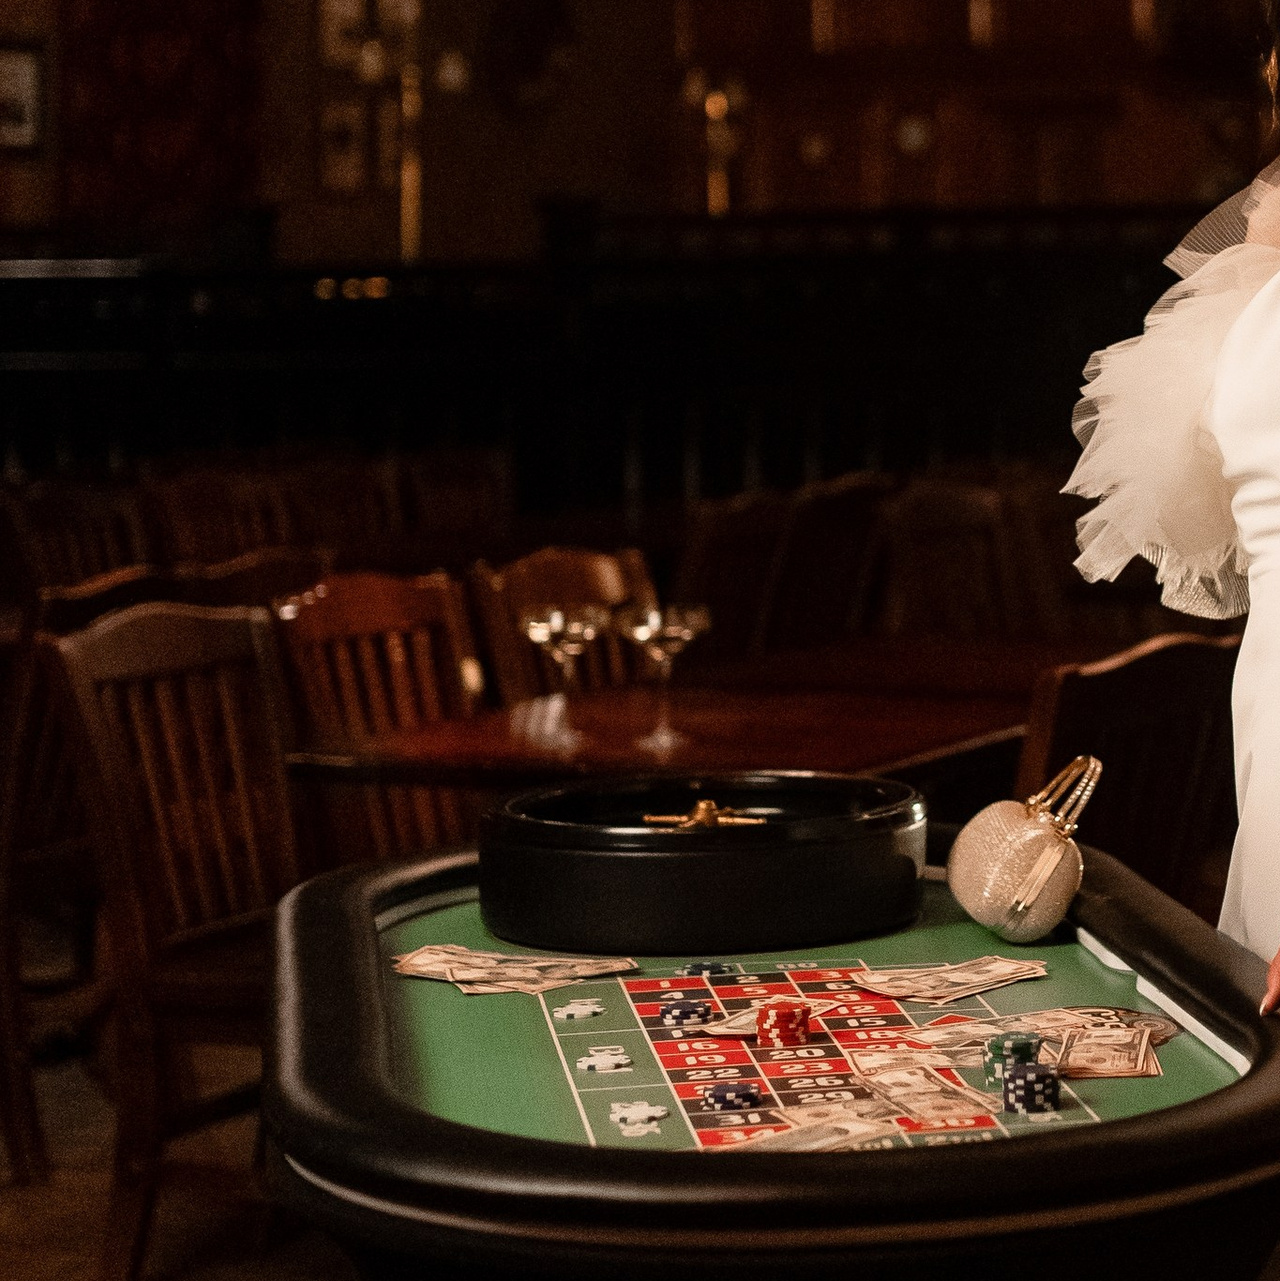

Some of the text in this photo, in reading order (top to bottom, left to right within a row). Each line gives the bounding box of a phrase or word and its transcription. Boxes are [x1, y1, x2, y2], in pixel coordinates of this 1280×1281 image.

[821, 971, 842, 979] 3
[742, 987, 769, 995] 5
[826, 982, 852, 990] 6
[660, 991, 684, 999] 4
[838, 1005, 879, 1015] 12
[847, 1018, 887, 1027] 15
[855, 1030, 899, 1040] 18
[677, 1041, 719, 1051] 16
[769, 1048, 825, 1059] 20
[685, 1055, 726, 1065] 19
[780, 1063, 833, 1074] 23
[686, 1068, 742, 1080] 22
[788, 1076, 844, 1088] 26
[797, 1091, 855, 1103] 29
[719, 1113, 761, 1125] 31
